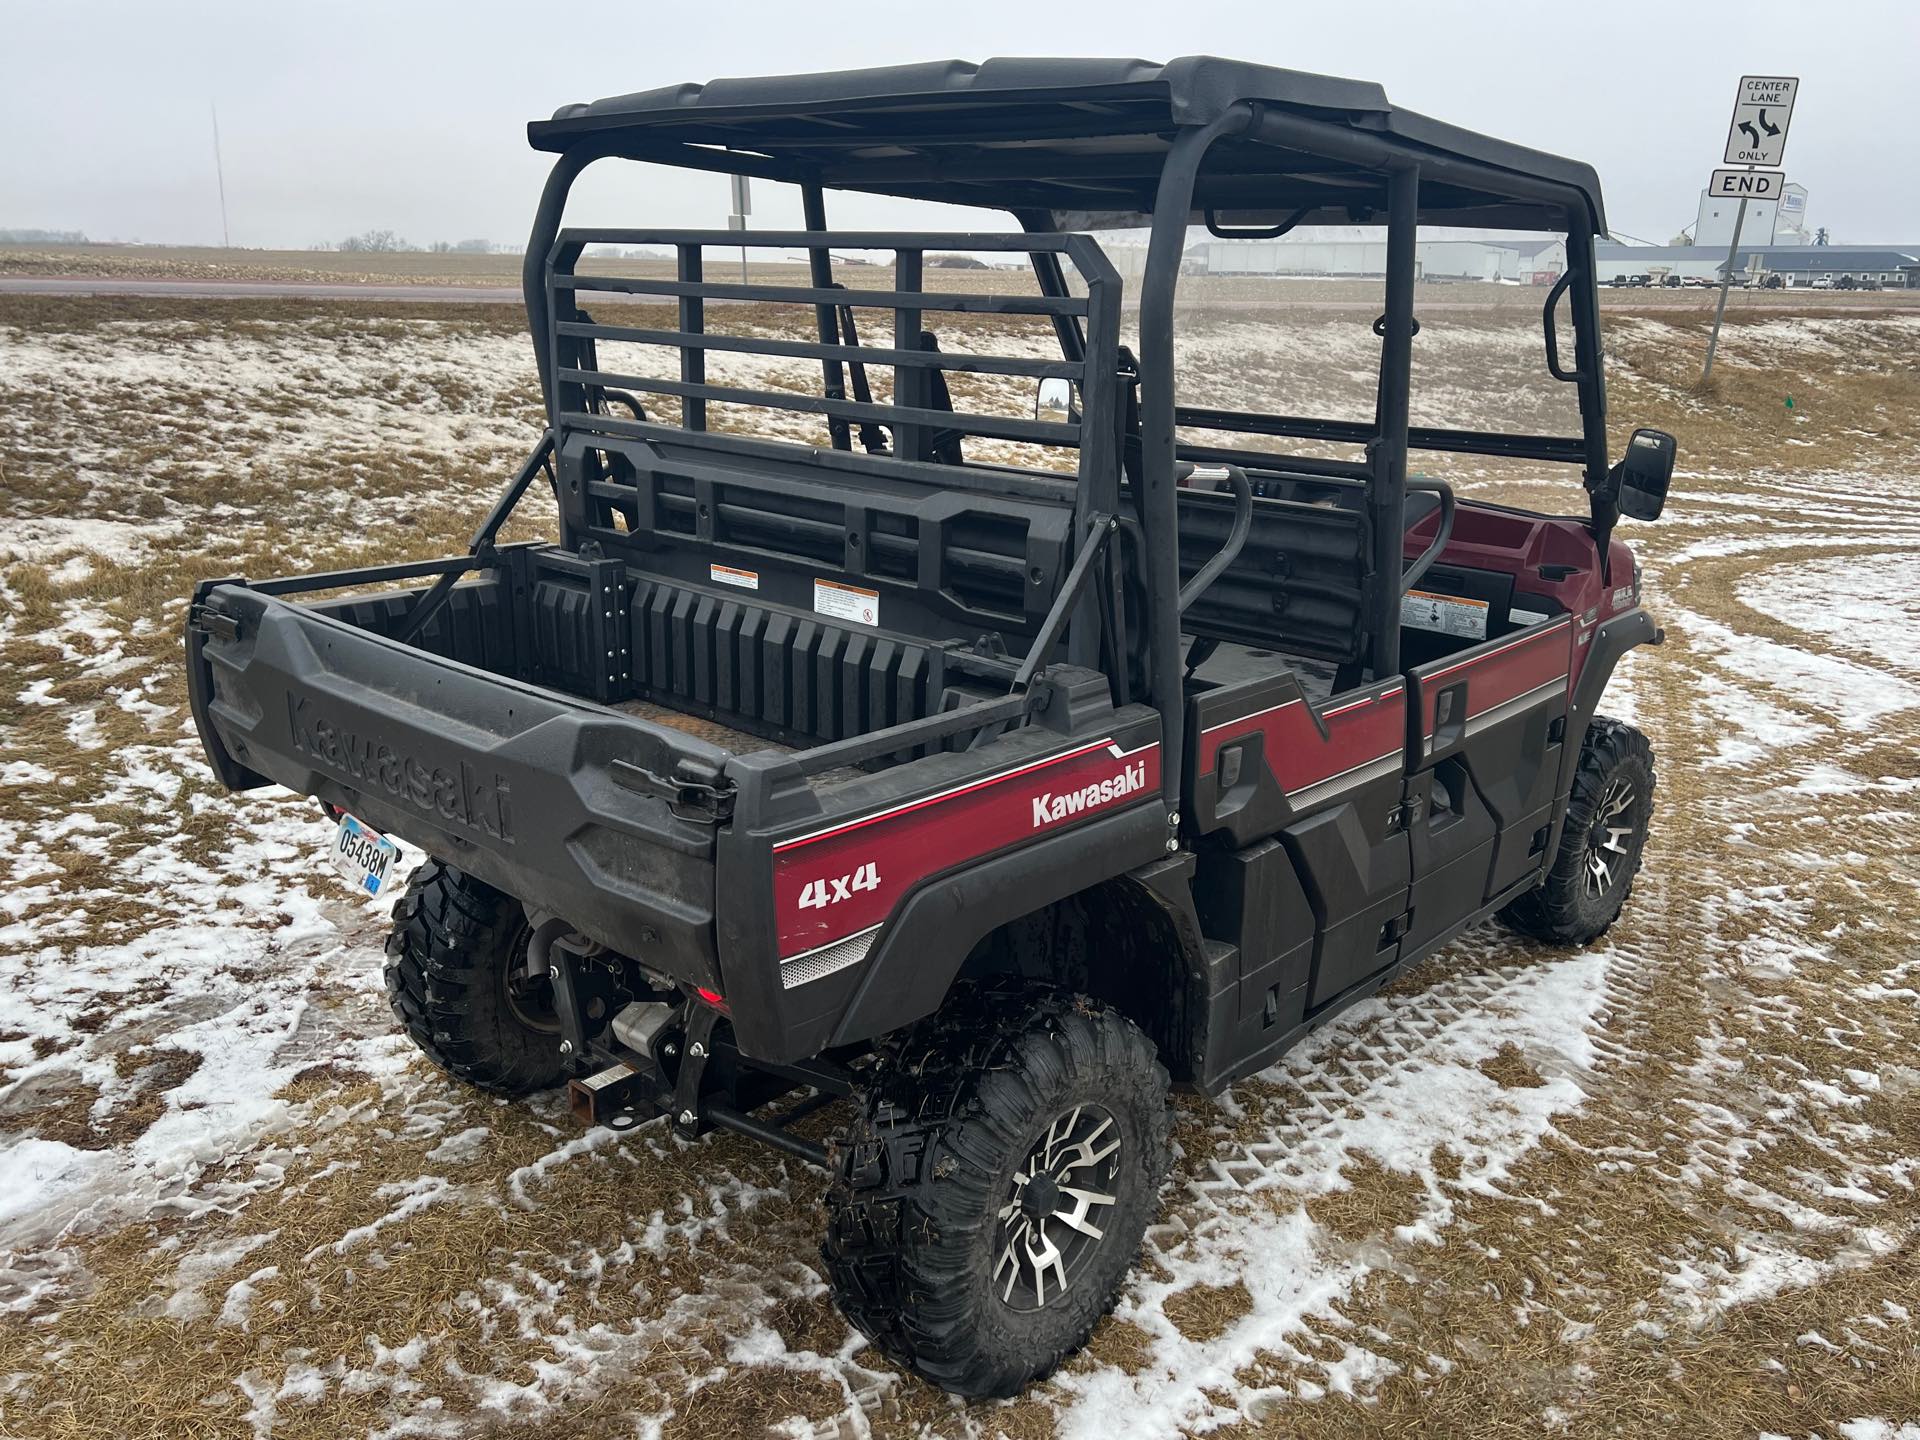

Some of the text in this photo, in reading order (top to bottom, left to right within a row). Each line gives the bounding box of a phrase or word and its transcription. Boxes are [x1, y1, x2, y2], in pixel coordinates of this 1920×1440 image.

[1747, 81, 1789, 91] CENTER
[1750, 93, 1780, 102] LANE
[1738, 151, 1768, 160] ONLY
[1722, 176, 1770, 193] END
[286, 689, 516, 845] Kawasaki
[1032, 760, 1146, 828] Kawasaki
[339, 829, 389, 880] 05438M
[798, 861, 882, 910] 4x4
